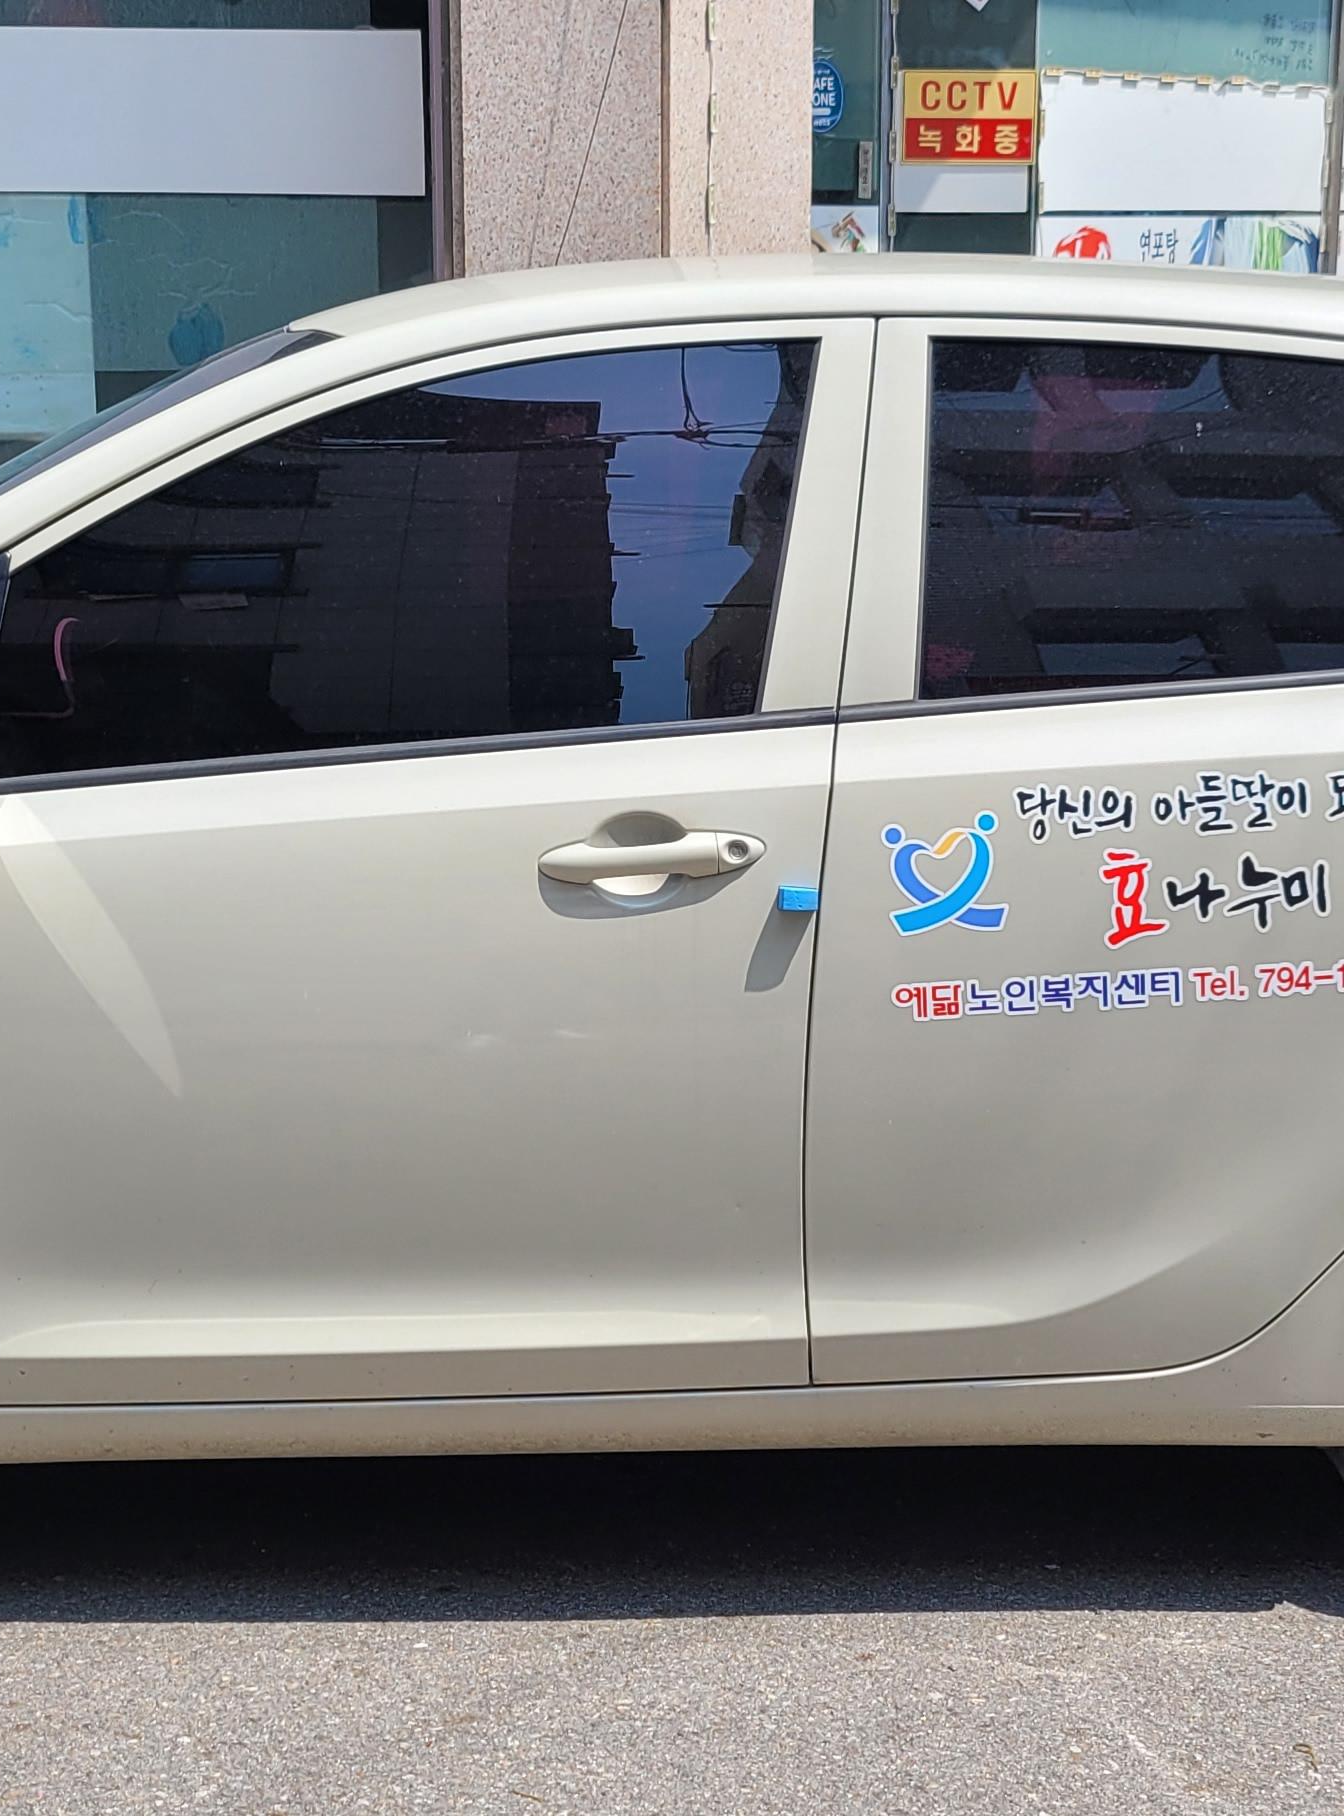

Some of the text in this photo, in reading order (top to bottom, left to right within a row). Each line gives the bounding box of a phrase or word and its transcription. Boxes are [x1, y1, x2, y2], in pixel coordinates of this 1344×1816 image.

[811, 93, 837, 106] ONE
[812, 77, 835, 91] AFE
[920, 80, 1019, 111] CCTV
[917, 124, 1019, 155] 녹화중
[1139, 228, 1179, 264] 연포탕
[1016, 787, 1133, 841] 당신의
[1154, 774, 1308, 832] 아들딸이
[1193, 969, 1246, 997] Tel.
